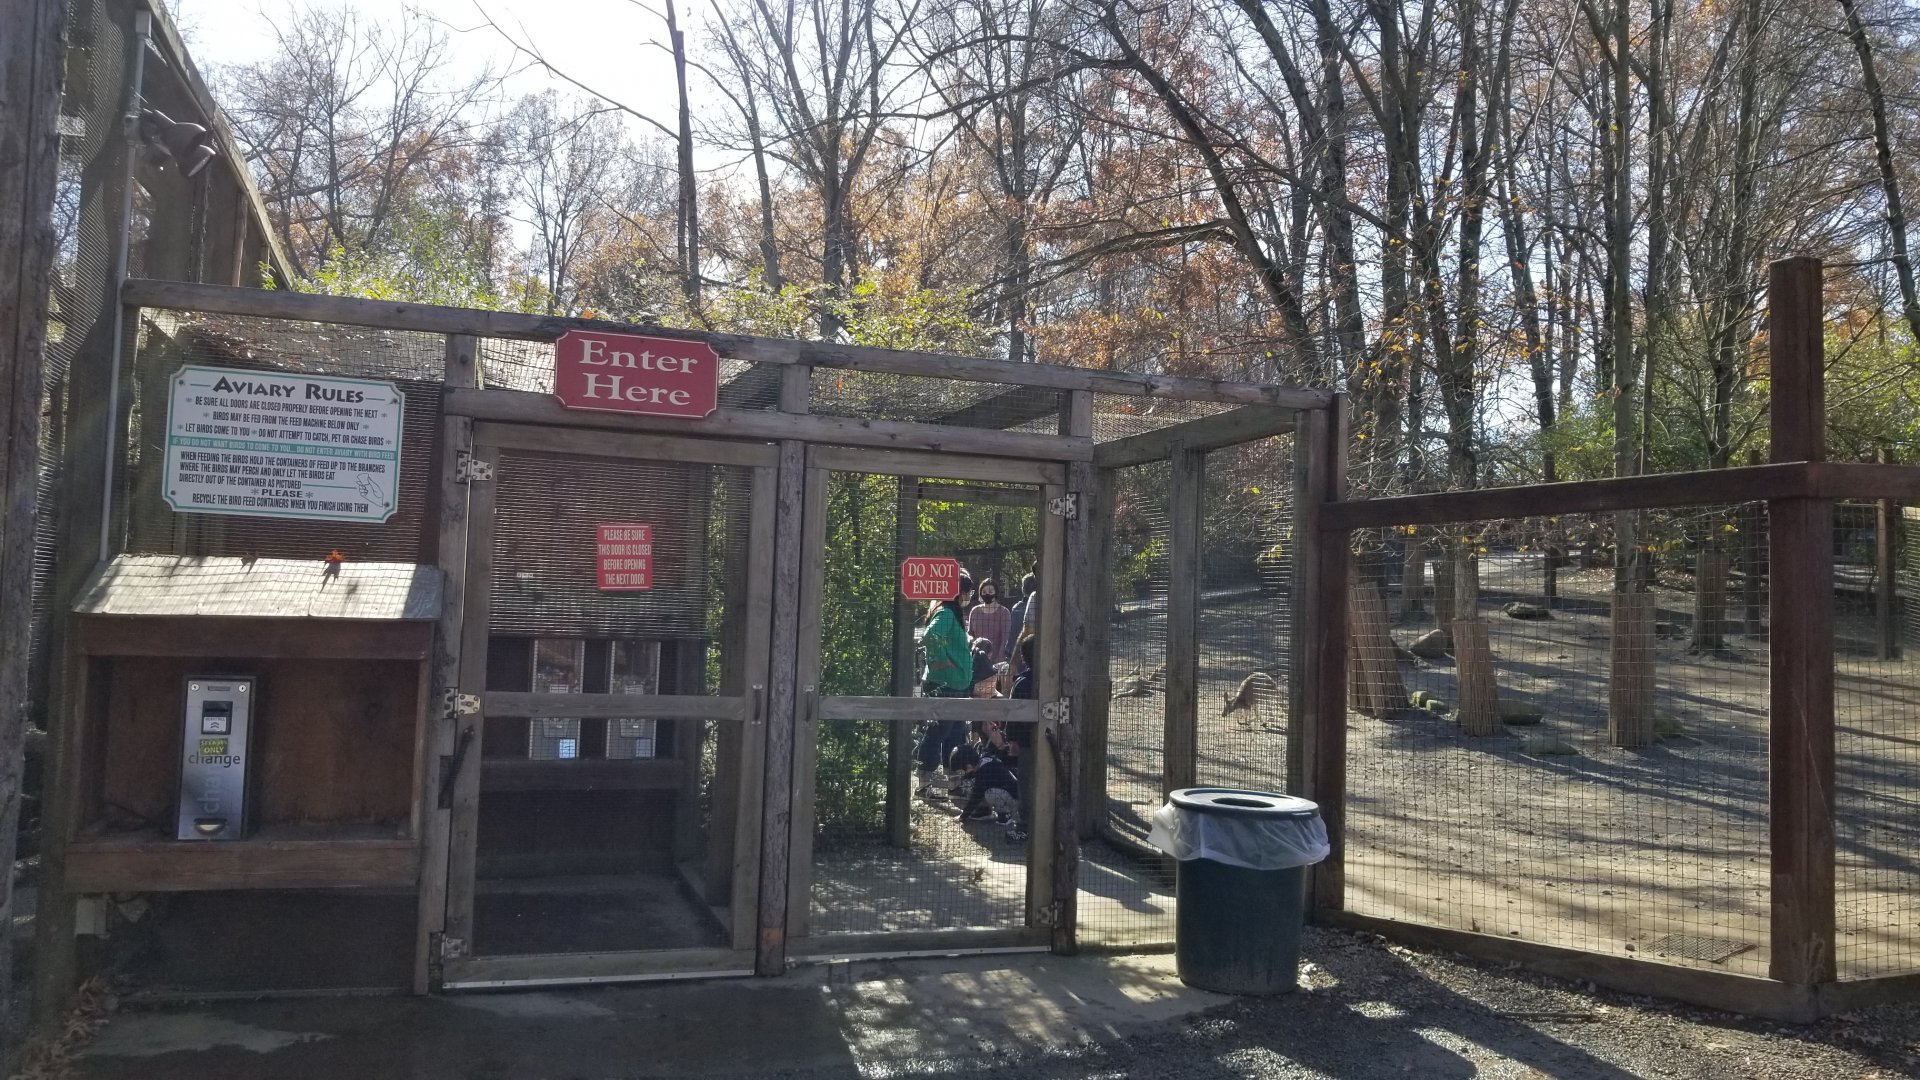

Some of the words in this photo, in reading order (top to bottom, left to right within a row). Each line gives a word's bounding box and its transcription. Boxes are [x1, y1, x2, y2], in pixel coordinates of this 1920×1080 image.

[579, 339, 698, 374] Enter
[213, 376, 295, 398] AVIARY
[305, 384, 364, 403] RULES
[583, 372, 690, 406] Here
[195, 396, 202, 406] BE
[203, 397, 218, 407] SURE
[219, 398, 229, 407] ALL
[230, 399, 248, 409] DOORS
[249, 400, 260, 410] ARE
[261, 401, 281, 411] CLOSED
[282, 403, 308, 413] PROPERLY
[309, 405, 329, 415] BEFORE
[330, 407, 352, 417] OPENING
[353, 408, 363, 417] THE
[365, 409, 378, 418] NEXT
[213, 411, 230, 421] BIRDS
[230, 412, 242, 422] MAY
[243, 413, 250, 422] BE
[251, 414, 261, 423] FED
[262, 415, 277, 424] FROM
[278, 416, 288, 425] THE
[289, 417, 302, 426] FEED
[303, 418, 327, 428] MACHINE
[327, 419, 345, 429] BELOW
[346, 421, 359, 430] ONLY
[185, 423, 195, 432] LET
[197, 424, 213, 433] BIRDS
[214, 425, 229, 435] COME
[231, 426, 238, 435] TO
[239, 427, 250, 436] YOU
[259, 428, 266, 437] DO
[267, 429, 278, 438] NOT
[279, 430, 303, 440] ATTEMPT
[305, 432, 311, 441] TO
[312, 432, 331, 443] CATCH,
[331, 434, 341, 442] PET
[342, 435, 350, 443] OR
[351, 435, 367, 445] CHASE
[368, 437, 384, 446] BIRDS
[305, 446, 315, 454] NOT
[317, 447, 333, 455] ENTER
[334, 448, 352, 456] AVIARY
[354, 450, 368, 458] WITH
[180, 451, 196, 460] WHEN
[197, 452, 219, 462] FEEDING
[221, 454, 231, 463] THE
[232, 455, 248, 464] BIRDS
[249, 456, 263, 465] HOLD
[265, 456, 275, 465] THE
[276, 457, 308, 468] CONTAINERS
[309, 460, 316, 469] OF
[317, 461, 329, 470] FEED
[330, 462, 337, 470] UP
[340, 462, 346, 470] TO
[347, 463, 358, 471] THE
[358, 463, 385, 473] BRANCHES
[180, 462, 199, 471] WHERE
[200, 463, 211, 472] THE
[212, 464, 228, 473] BIRDS
[229, 465, 240, 474] MAY
[242, 466, 259, 475] PERCH
[260, 467, 271, 476] AND
[273, 468, 285, 477] ONLY
[286, 469, 296, 477] LET
[298, 469, 308, 478] THE
[309, 470, 325, 479] BIRDS
[326, 472, 335, 480] EAT
[179, 473, 204, 483] DIRECTLY
[205, 475, 216, 484] OUT
[218, 476, 225, 484] OF
[226, 476, 236, 485] THE
[238, 477, 266, 487] CONTAINER
[268, 479, 274, 487] AS
[276, 479, 301, 489] PICTURED
[262, 489, 302, 497] PLEASE
[192, 493, 216, 504] RECYCLE
[217, 495, 227, 504] THE
[229, 496, 242, 505] BIRD
[243, 497, 255, 506] FEED
[257, 497, 289, 508] CONTAINERS
[290, 500, 306, 510] WHEN
[308, 500, 319, 510] YOU
[319, 501, 336, 511] FINISH
[337, 502, 353, 512] USING
[353, 503, 369, 513] THEM
[604, 529, 623, 540] PLEASE
[624, 529, 631, 540] BE
[632, 530, 645, 541] SURE
[598, 544, 610, 555] THIS
[611, 544, 625, 555] DOOR
[626, 544, 631, 555] IS
[632, 544, 651, 555] CLOSED
[604, 559, 623, 570] BEFORE
[624, 559, 646, 570] OPENING
[908, 563, 926, 577] DO
[930, 563, 954, 577] NOT
[605, 573, 616, 584] THE
[616, 573, 629, 584] NEXT
[631, 573, 644, 584] DOOR
[913, 580, 949, 594] ENTER
[204, 746, 224, 754] ONLY
[188, 752, 240, 768] change
